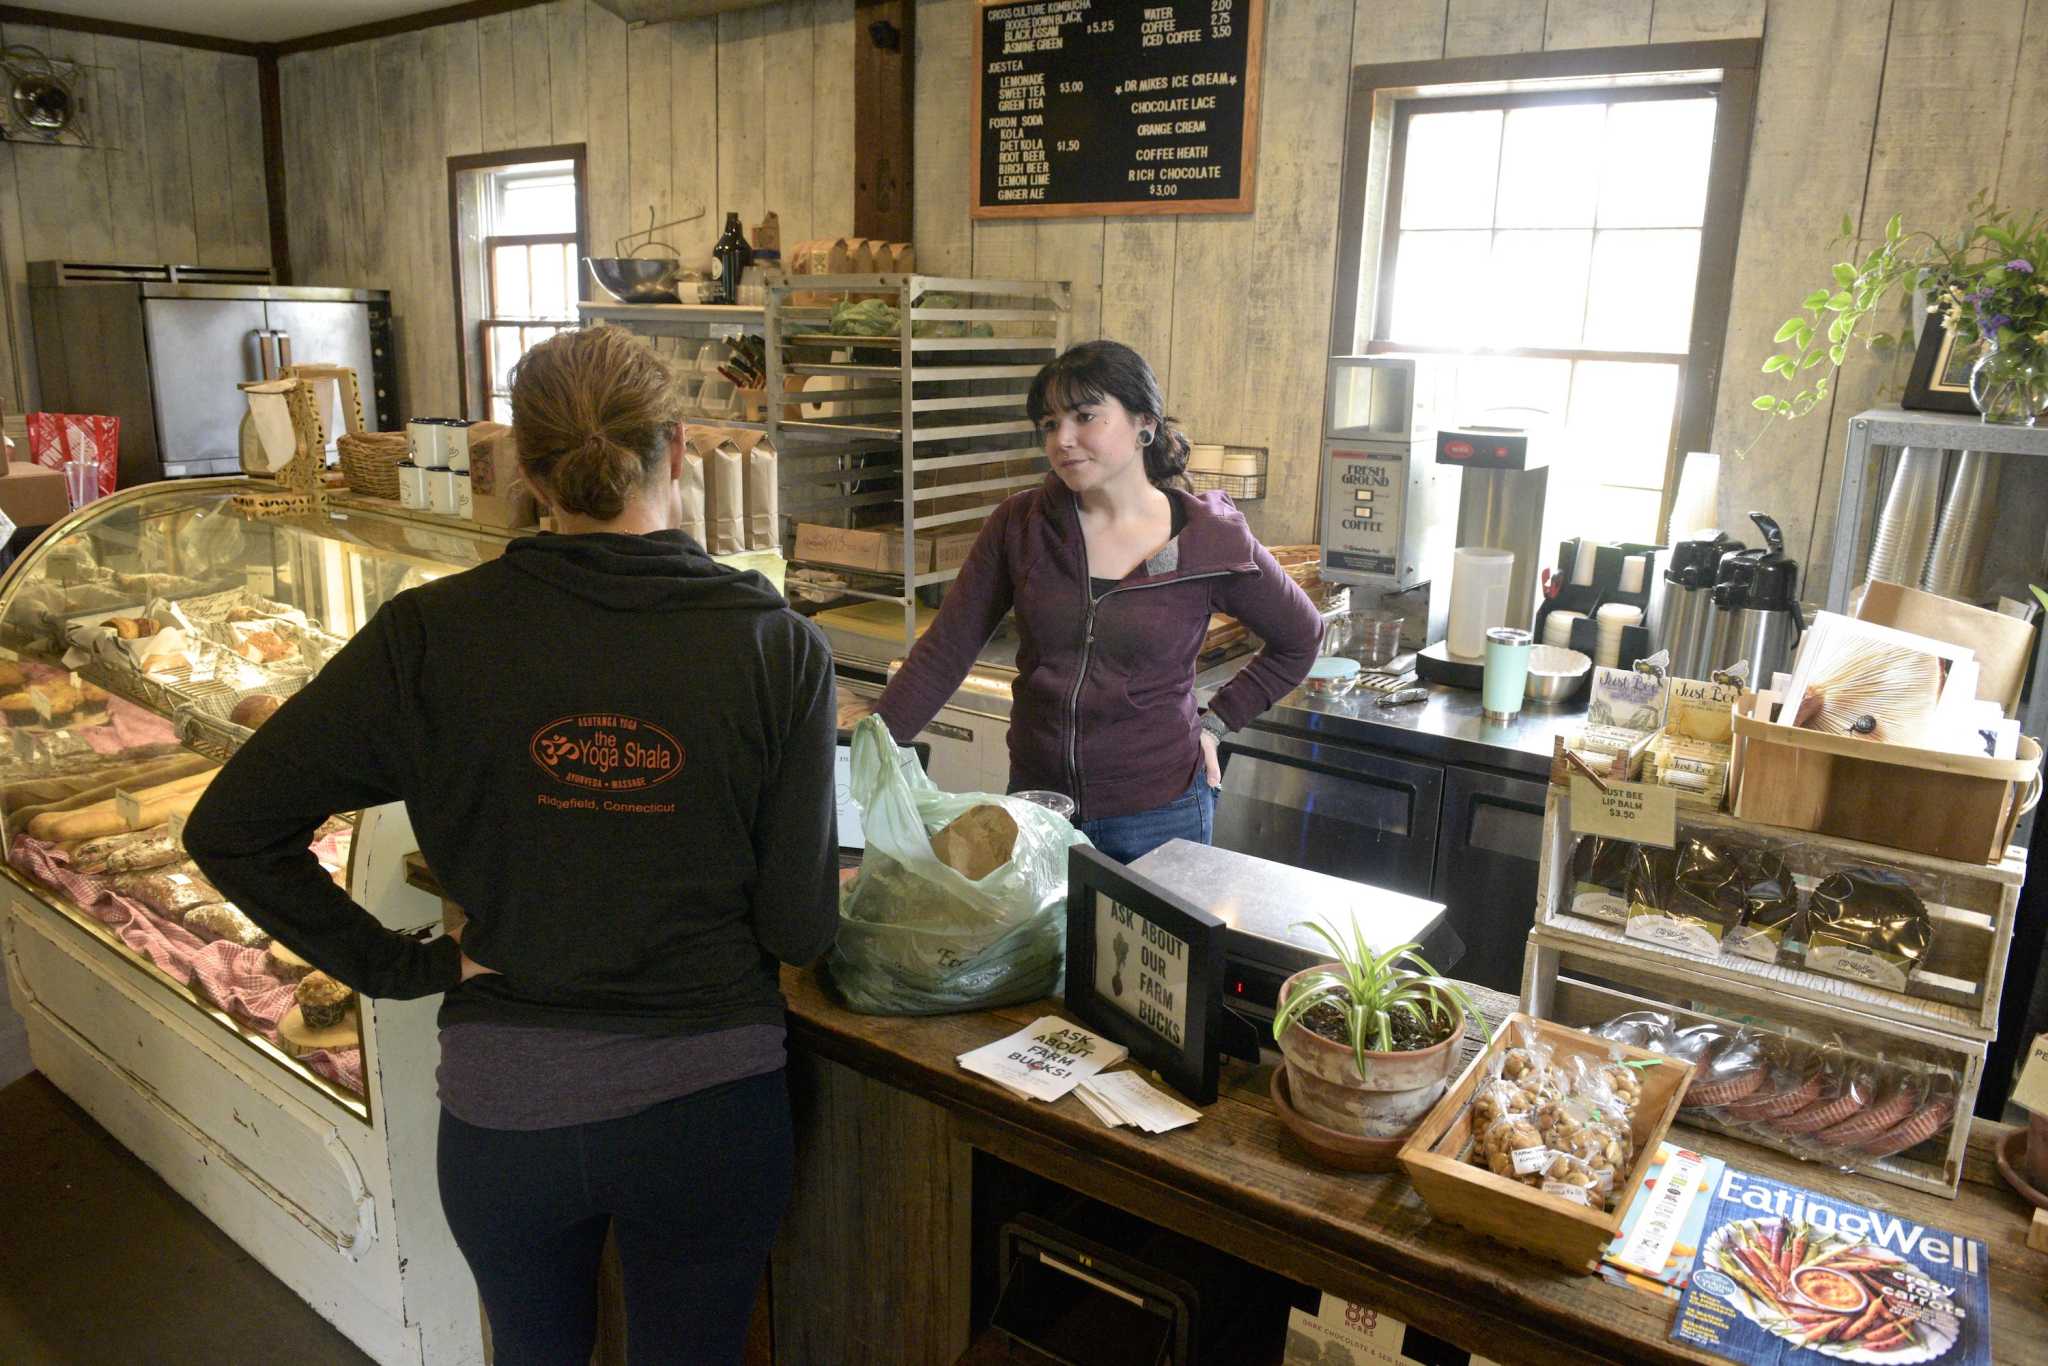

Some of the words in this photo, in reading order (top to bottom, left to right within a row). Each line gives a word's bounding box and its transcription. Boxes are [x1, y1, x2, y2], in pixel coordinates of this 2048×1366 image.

[988, 8, 1012, 21] CROSS
[1013, 4, 1046, 17] CULTURE
[1048, 0, 1092, 14] KOMBUCHA
[1143, 6, 1174, 20] WATER
[1032, 15, 1055, 28] DOWN
[1056, 12, 1082, 25] BLACK
[1141, 19, 1177, 34] COFFEE
[1211, 12, 1230, 26] 2.75
[1004, 28, 1031, 41] BLACK
[1032, 26, 1059, 38] ASSAM
[1087, 20, 1115, 34] $5.25
[1211, 25, 1232, 39] 3.50
[1002, 41, 1035, 54] JASMINE
[1036, 37, 1063, 50] GREEN
[1142, 33, 1163, 47] ICED
[1166, 29, 1202, 45] COFFEE
[1000, 73, 1045, 88] LEMONADE
[1060, 81, 1083, 93] $3.00
[1124, 79, 1138, 93] DR
[1139, 76, 1168, 92] MIKES
[1171, 74, 1189, 88] ICE
[1191, 71, 1229, 86] CREAM
[999, 87, 1026, 99] SWEET
[1029, 86, 1045, 97] TEA
[998, 99, 1024, 111] GREEN
[1027, 97, 1044, 109] TEA
[1131, 98, 1189, 114] CHOCOLATE
[1191, 96, 1216, 110] LACE
[1021, 114, 1043, 127] SODA
[1137, 122, 1173, 136] ORANGE
[1175, 120, 1207, 134] CREAM
[1000, 127, 1024, 139] KOLA
[1000, 140, 1019, 151] DIET
[1021, 138, 1043, 150] KOLA
[1057, 140, 1080, 152] $1.50
[999, 151, 1019, 163] ROOT
[1022, 150, 1045, 161] BEER
[1136, 148, 1175, 161] COFFEE
[1176, 145, 1208, 159] HEATH
[999, 163, 1023, 175] BIRCH
[1026, 162, 1049, 173] BEER
[1128, 169, 1155, 182] RICH
[1160, 165, 1222, 180] CHOCOLATE
[998, 175, 1027, 187] LEMON
[1030, 173, 1050, 185] LIME
[997, 188, 1028, 200] GINGER
[1029, 187, 1045, 199] ALE
[1149, 184, 1177, 196] $3.00
[1347, 464, 1386, 478] FRESH
[1341, 473, 1389, 487] GROUND
[1342, 519, 1384, 533] COFFEE
[1676, 682, 1705, 698] Just
[595, 730, 617, 748] the
[578, 738, 619, 773] Yoga
[624, 741, 671, 769] Shala
[1626, 790, 1644, 800] BEE
[603, 800, 676, 813] Connecticut
[1602, 798, 1616, 807] LIP
[1617, 800, 1643, 811] BALM
[1111, 902, 1134, 931] ASK
[1141, 918, 1184, 961] ABOUT
[1140, 945, 1167, 979] OUR
[1139, 972, 1173, 1012] FARM
[1138, 1000, 1181, 1045] BUCKS
[1057, 1028, 1095, 1045] ASK
[1032, 1034, 1094, 1058] ABOUT
[1027, 1045, 1076, 1067] FARM
[1007, 1052, 1072, 1079] BUCKS!
[1718, 1168, 1978, 1276] EatingWell
[1892, 1270, 1957, 1297] crazy
[1881, 1285, 1967, 1319] carrots
[1345, 1303, 1378, 1330] 88
